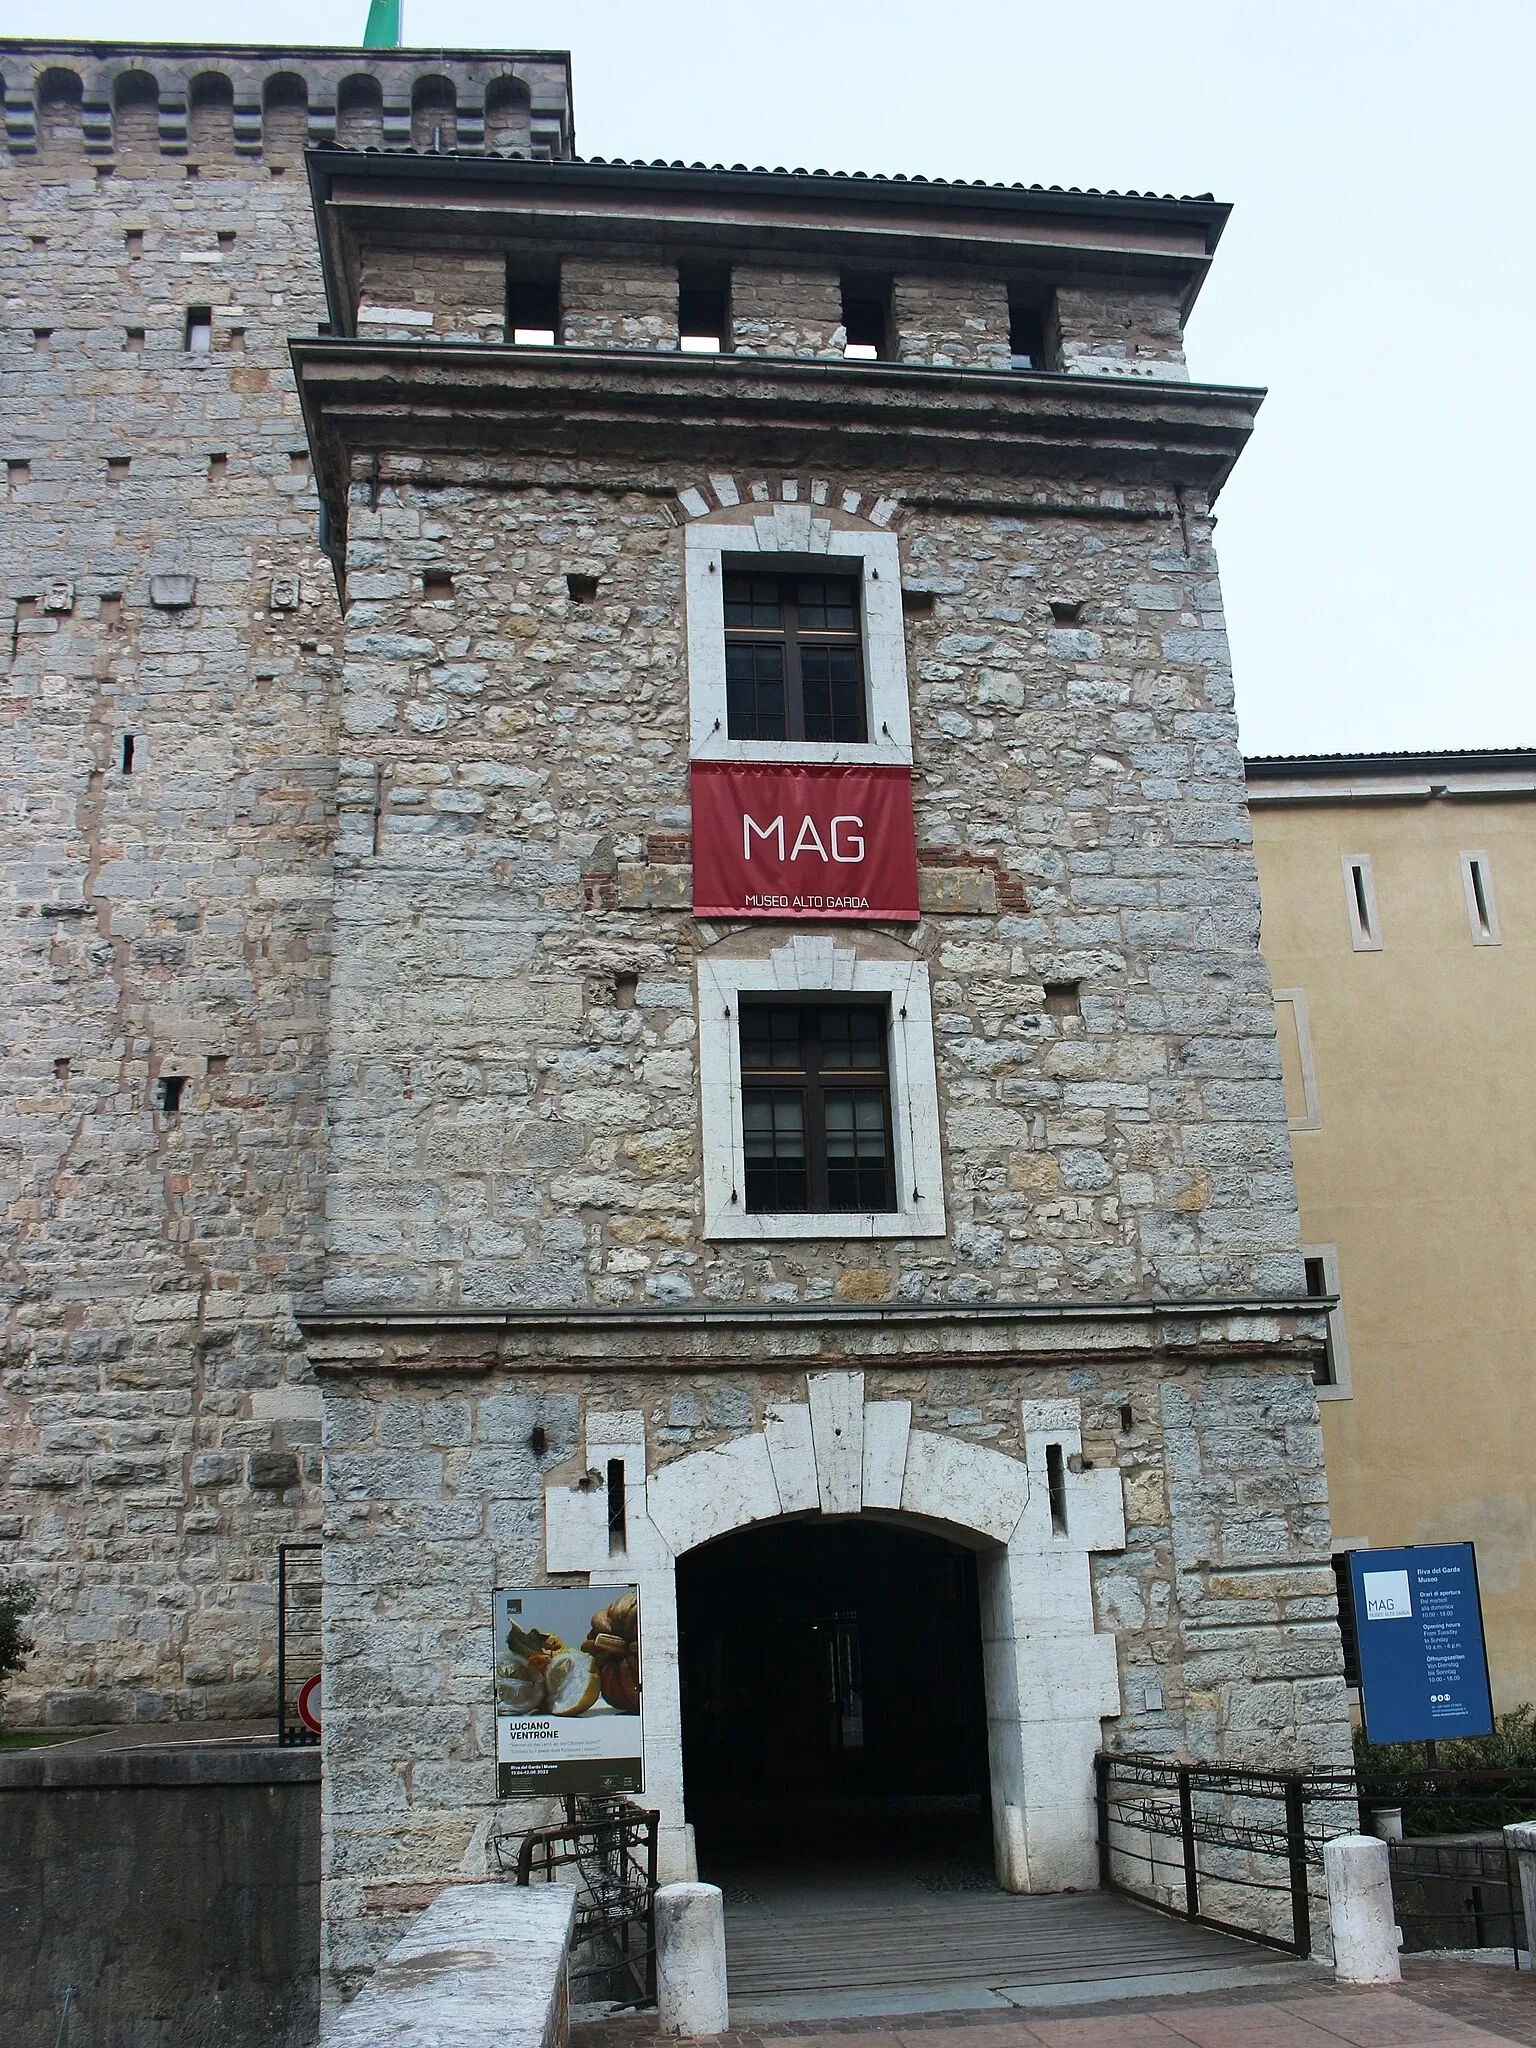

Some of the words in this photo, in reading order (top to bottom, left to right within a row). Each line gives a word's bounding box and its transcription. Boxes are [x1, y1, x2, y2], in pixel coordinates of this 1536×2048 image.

[744, 813, 865, 863] MAG
[745, 894, 788, 907] MUSEO
[792, 895, 823, 908] ALTO
[826, 896, 870, 908] GARDA
[1368, 1598, 1394, 1611] MAG
[1426, 1654, 1465, 1662] Öffnungszeiten
[510, 1722, 550, 1731] LUCIANO
[510, 1730, 559, 1740] VENTRONE
